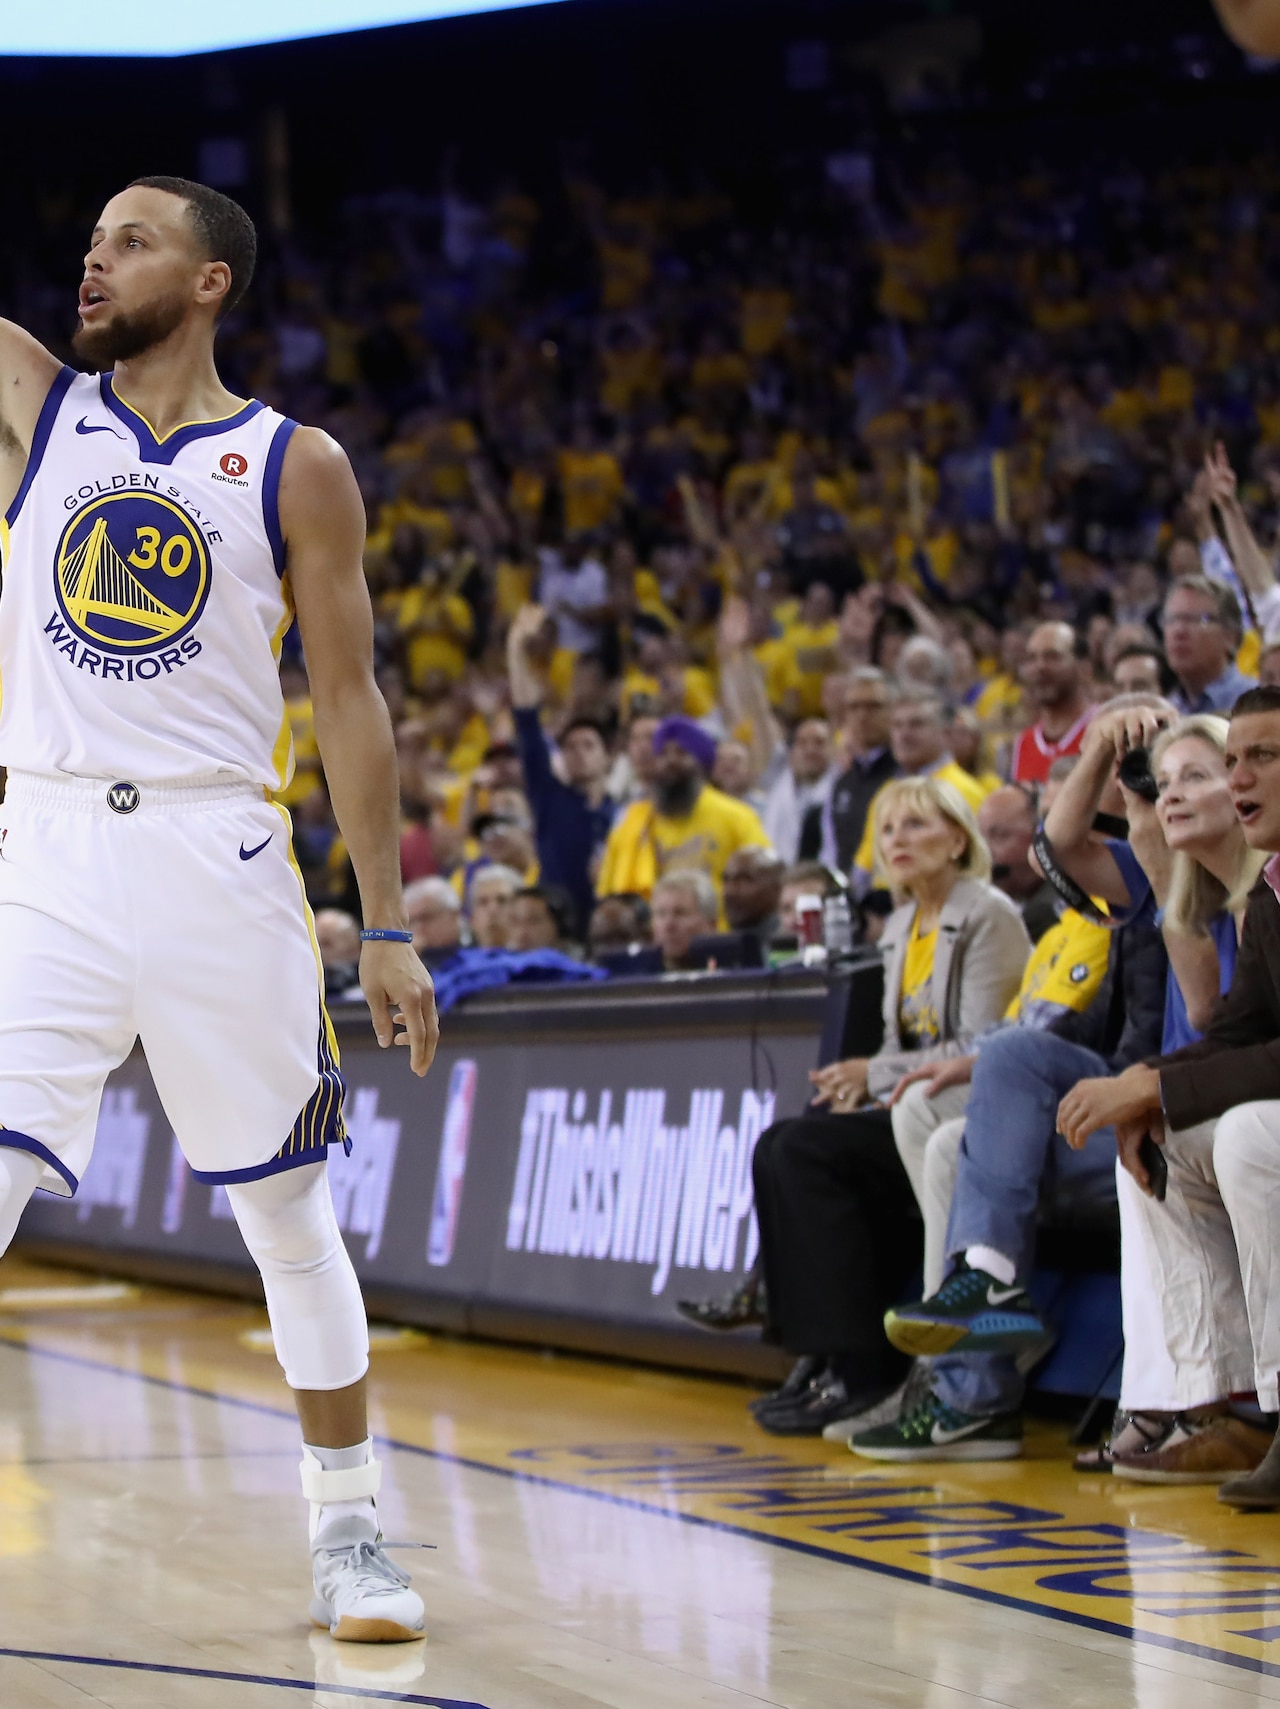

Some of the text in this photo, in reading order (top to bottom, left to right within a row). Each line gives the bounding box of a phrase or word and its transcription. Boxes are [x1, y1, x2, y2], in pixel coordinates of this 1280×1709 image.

[211, 472, 249, 487] Rakuten
[63, 473, 223, 546] GOLDEN STATE
[127, 526, 193, 578] 30
[43, 611, 203, 682] WARRIORS
[109, 789, 136, 808] W
